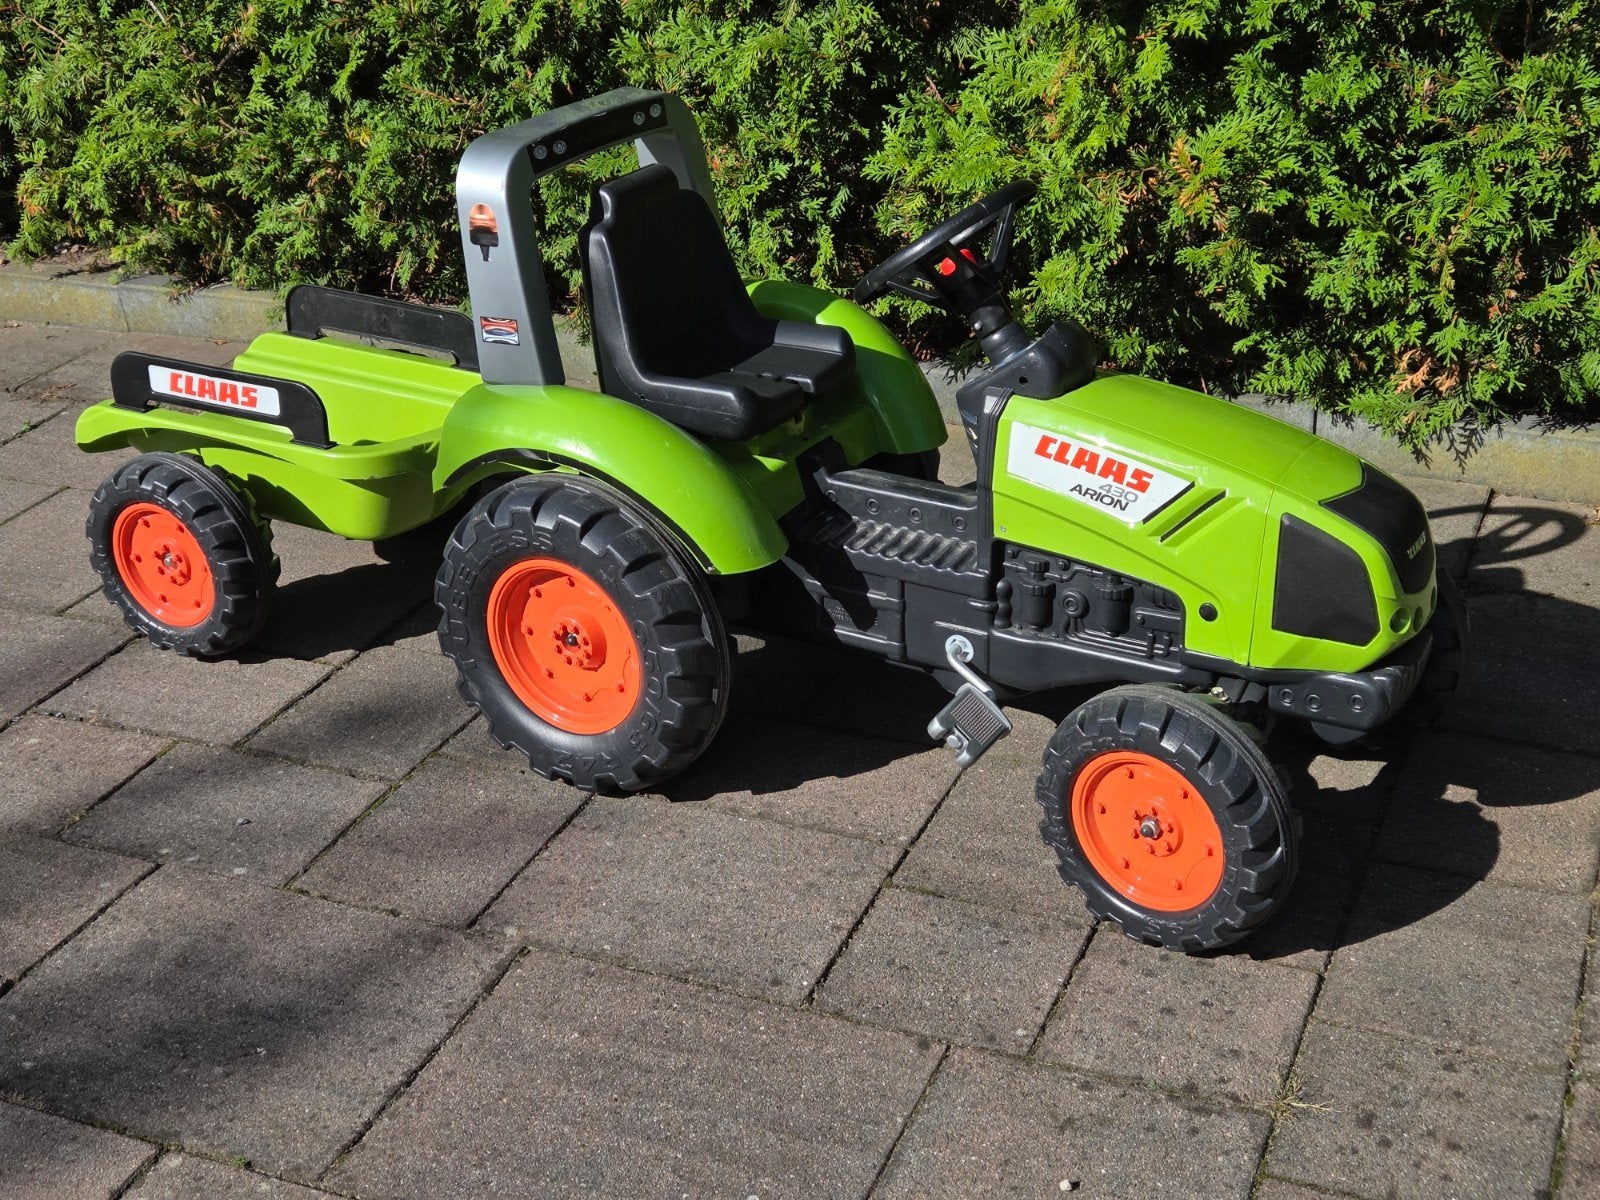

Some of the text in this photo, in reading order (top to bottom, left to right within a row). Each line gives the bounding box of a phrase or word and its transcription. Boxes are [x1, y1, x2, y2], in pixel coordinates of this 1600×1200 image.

[169, 371, 258, 409] CLAAS
[1034, 434, 1154, 494] CLAAS
[1069, 483, 1130, 512] ARION
[1098, 483, 1139, 503] 430
[449, 529, 555, 672] TUBELESS
